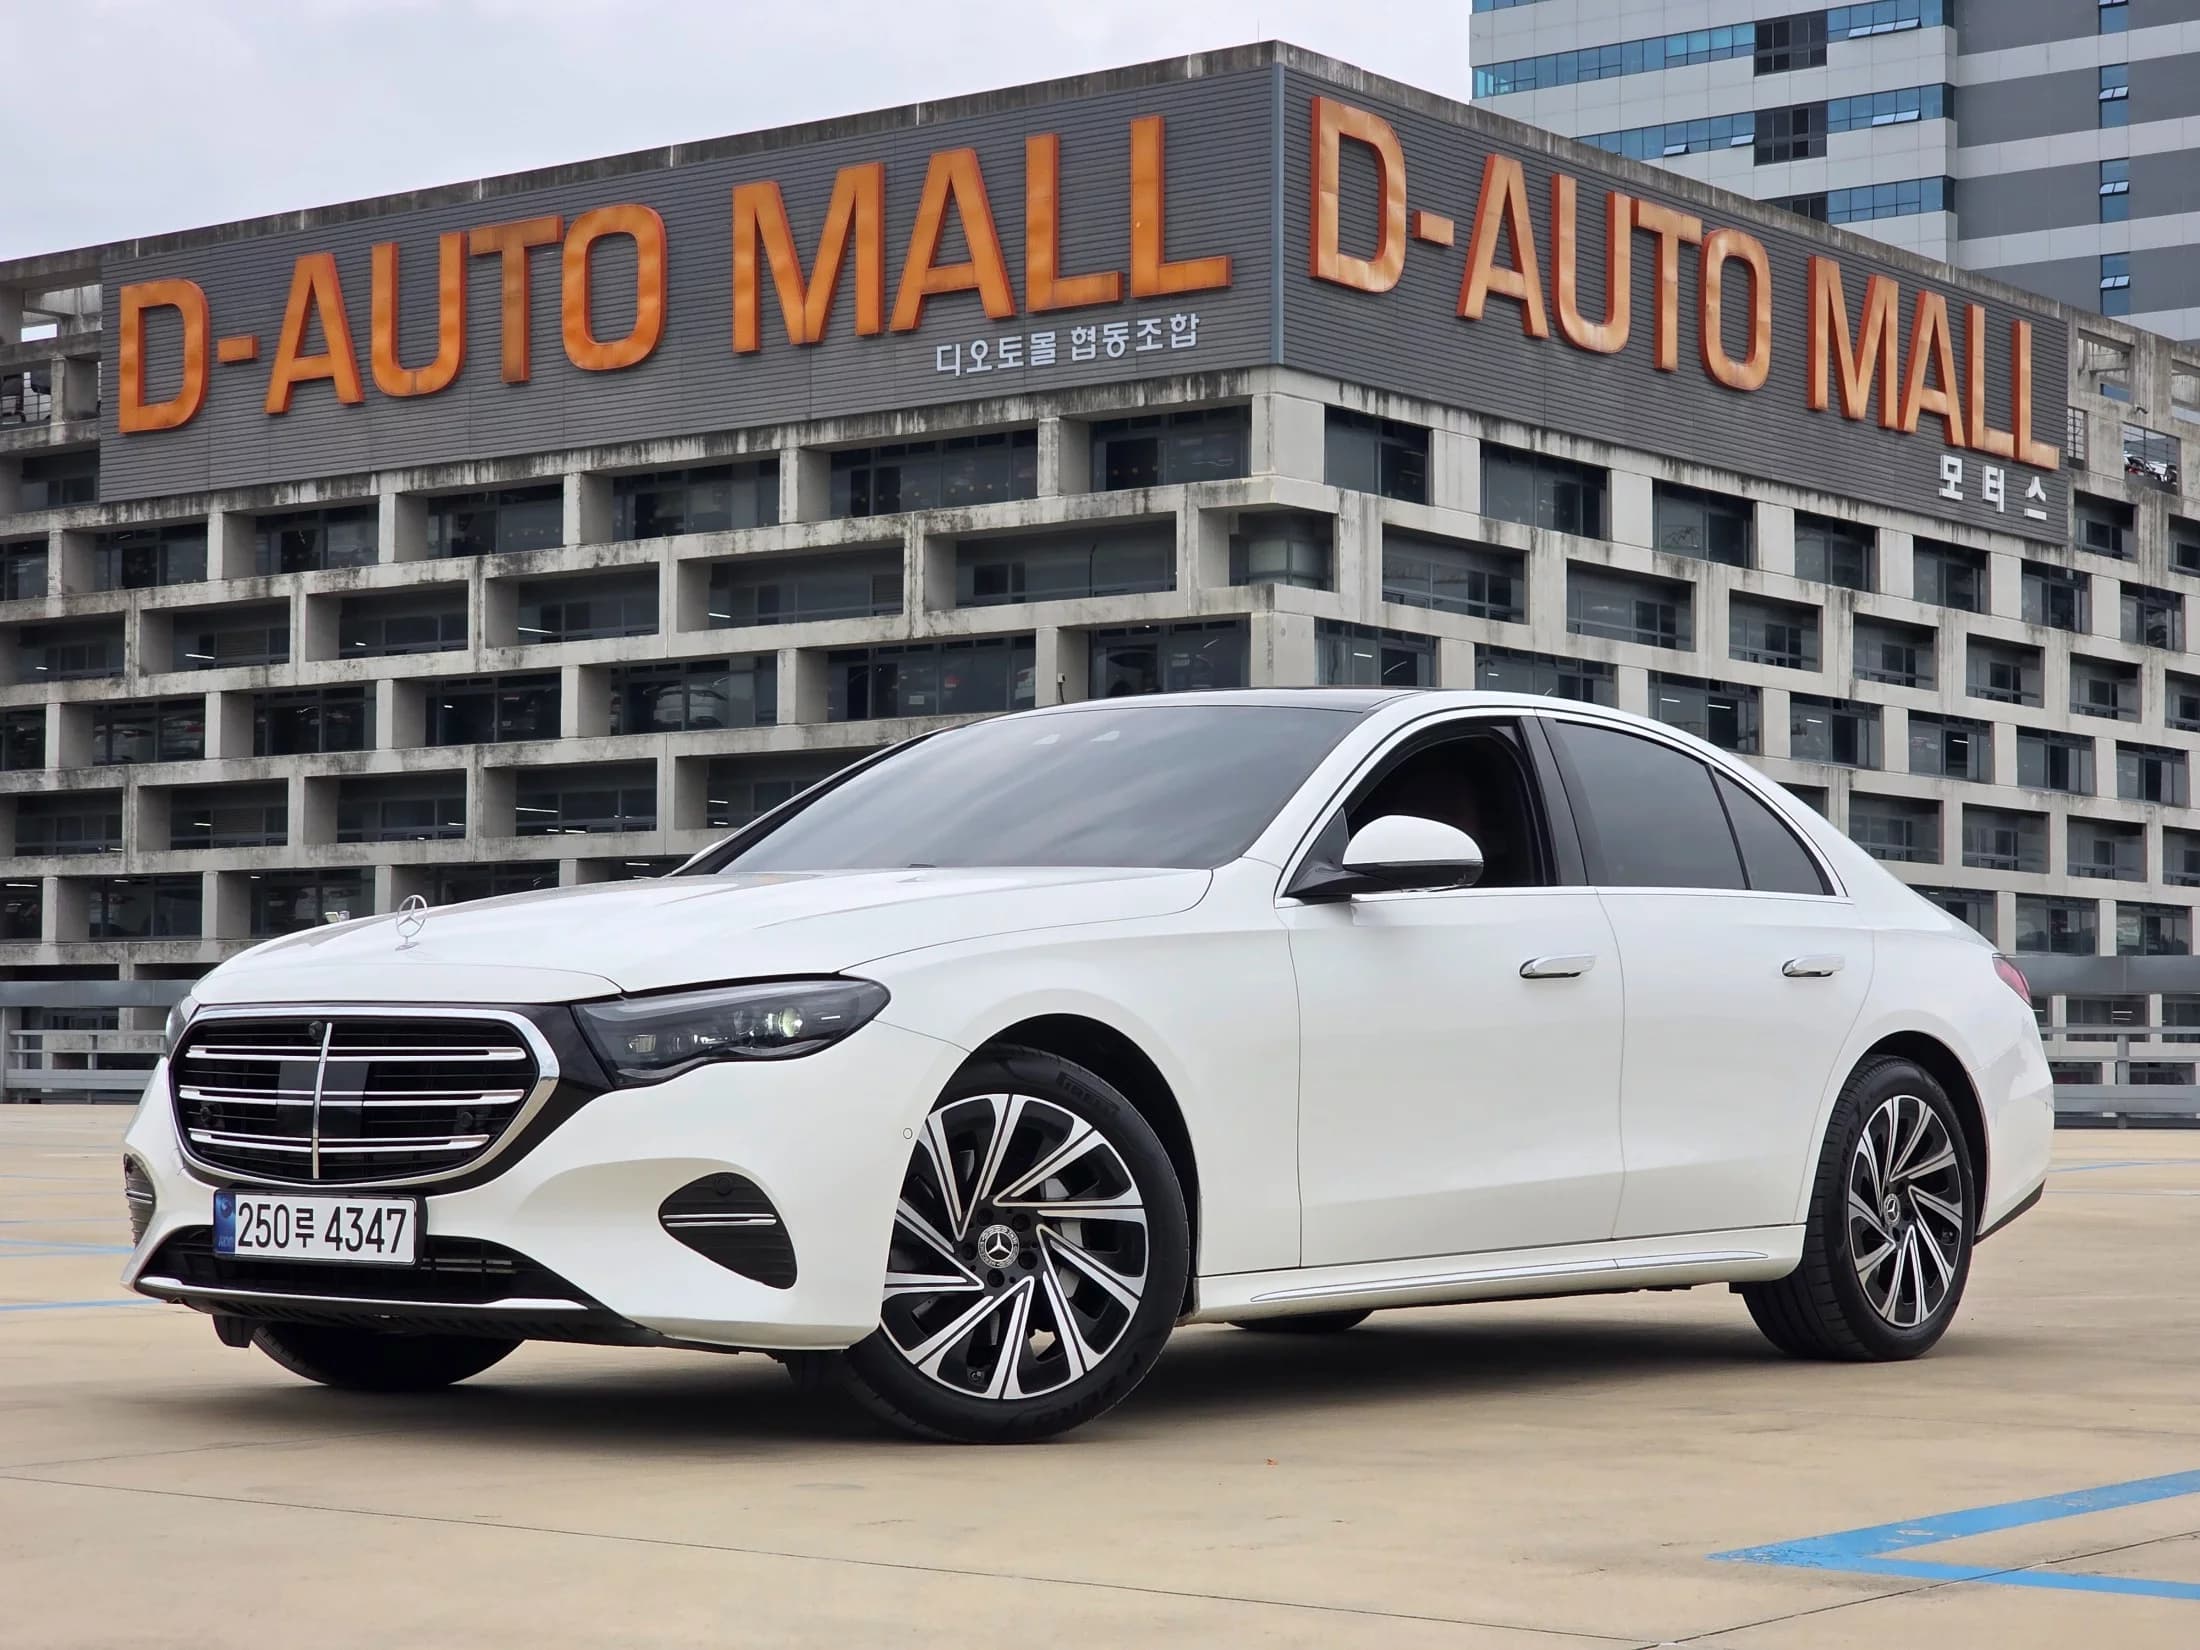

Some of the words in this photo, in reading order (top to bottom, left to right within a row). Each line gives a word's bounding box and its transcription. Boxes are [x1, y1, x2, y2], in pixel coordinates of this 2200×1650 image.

[118, 202, 668, 435] D-AUTO
[731, 114, 1233, 354] MALL
[935, 330, 1057, 377] 디오토몰
[1069, 312, 1200, 362] 협동조합
[1309, 95, 1773, 391] D-AUTO
[1807, 255, 2060, 470] MALL
[324, 1205, 408, 1254] 4347
